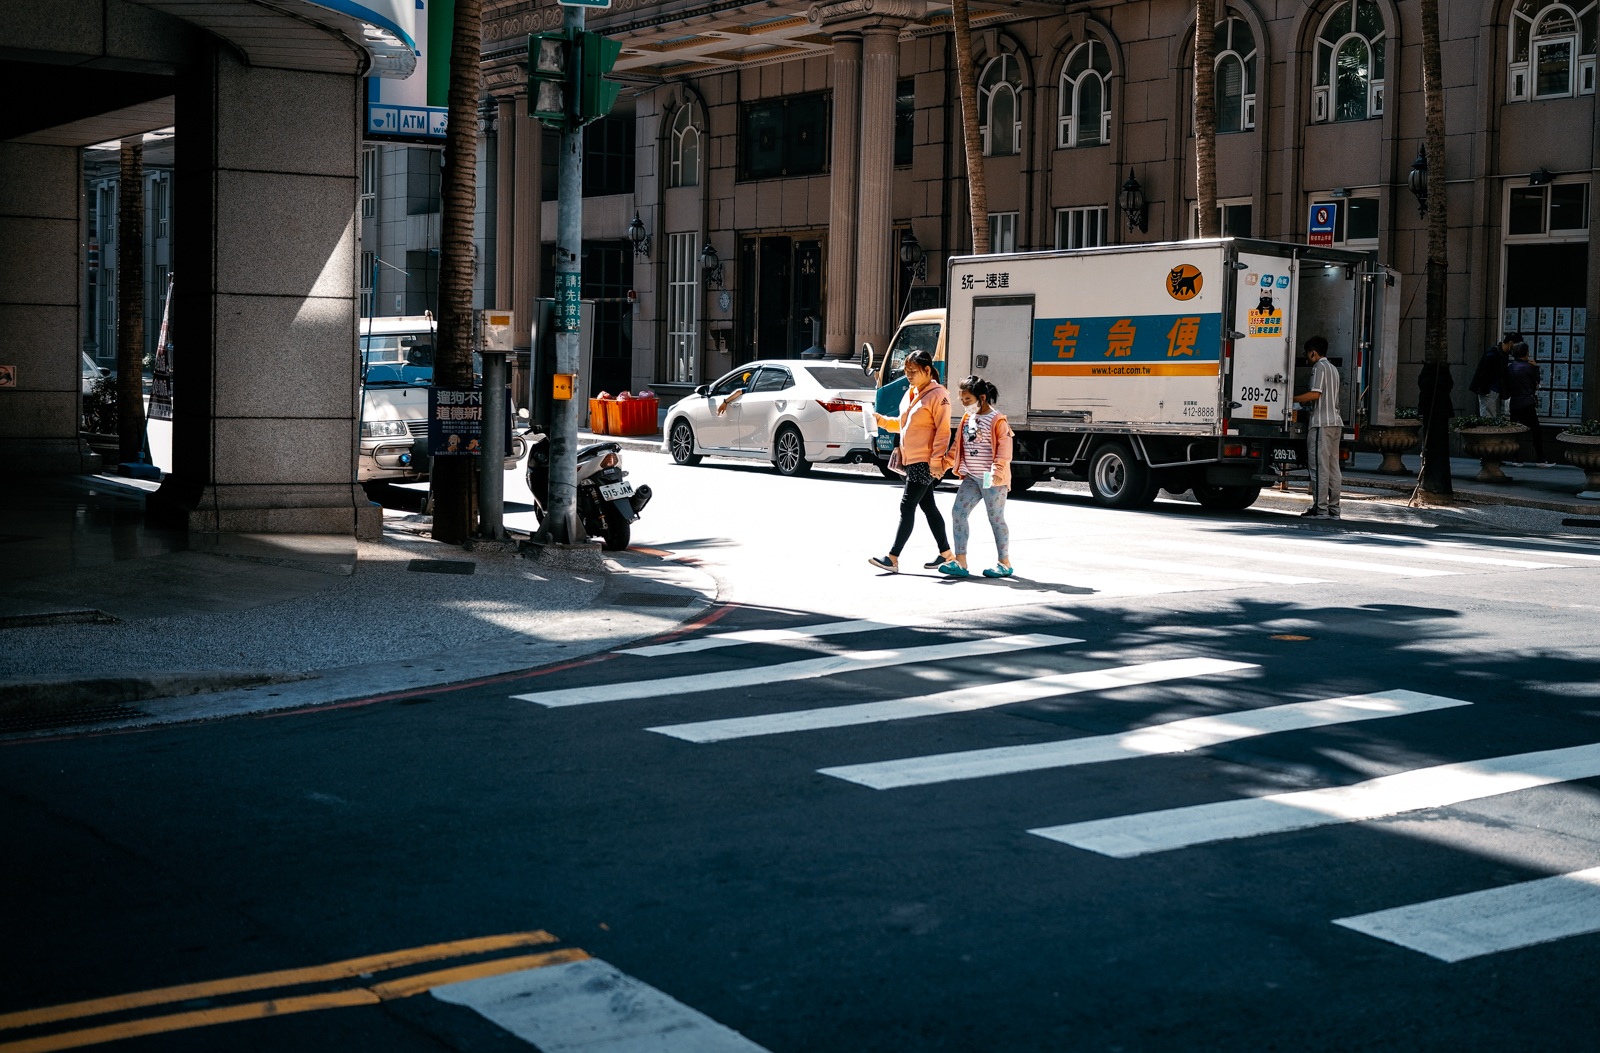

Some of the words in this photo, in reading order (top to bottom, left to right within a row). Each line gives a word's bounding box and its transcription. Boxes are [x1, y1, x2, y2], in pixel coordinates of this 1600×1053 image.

[402, 114, 425, 130] ATM
[433, 126, 446, 134] Wi
[961, 272, 1010, 290] 統一速達
[565, 274, 577, 327] 請先按鈕
[1051, 316, 1202, 359] 宅急便
[1091, 366, 1151, 375] www.t-cat.com.tw
[1241, 386, 1278, 403] 289-ZQ
[1183, 406, 1215, 417] 412-8888
[1273, 448, 1297, 460] 289-ZQ
